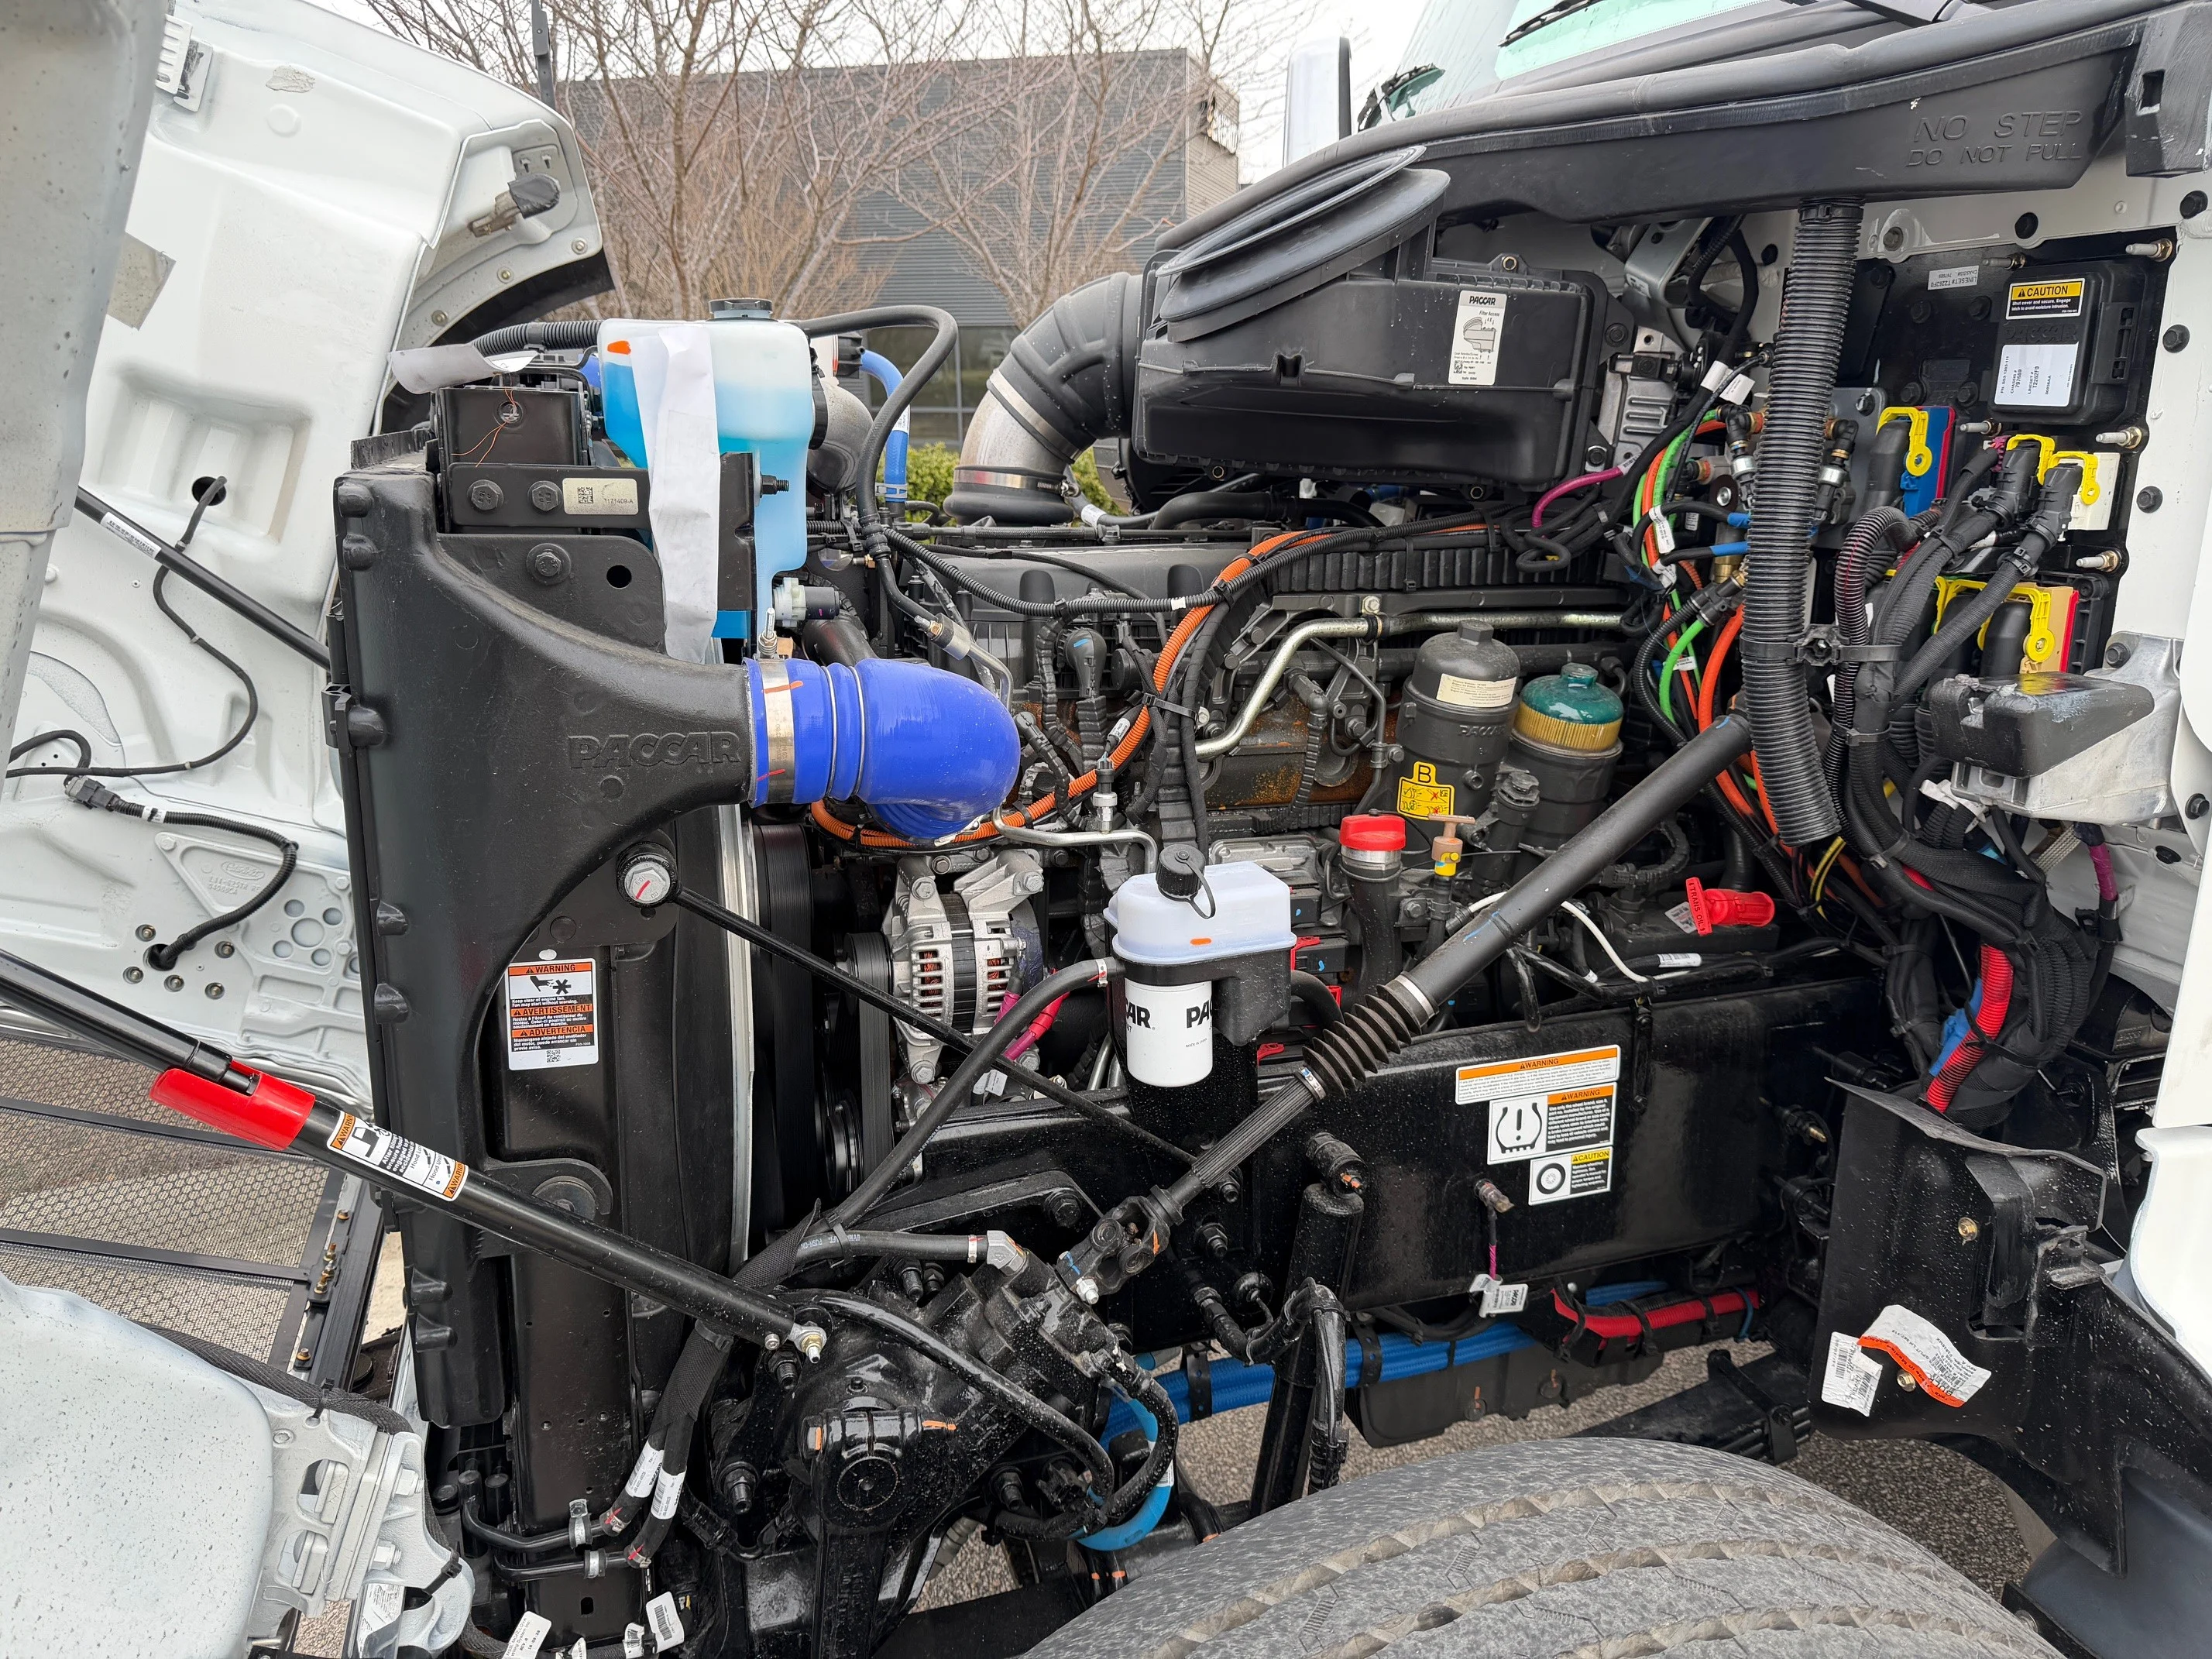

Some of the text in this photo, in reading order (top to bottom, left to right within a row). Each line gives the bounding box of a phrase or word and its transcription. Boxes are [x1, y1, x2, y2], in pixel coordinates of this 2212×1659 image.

[1914, 110, 2083, 143] NO STEP
[1906, 143, 2082, 167] DO NOT PULL
[2027, 286, 2069, 297] CAUTION
[1469, 296, 1496, 305] PACCAR
[568, 731, 741, 769] PACCAR
[1418, 764, 1431, 783] B
[1689, 887, 1701, 912] TRANS
[535, 964, 575, 973] WARNING
[523, 1005, 591, 1015] AVERTISSEMENT
[1126, 998, 1151, 1029] AR
[529, 1025, 586, 1036] ADVERTENCIA
[1525, 1058, 1559, 1070] WARNING
[1567, 1089, 1600, 1100] WARNING
[386, 1149, 397, 1170] ensure
[393, 1150, 406, 1172] engaged
[410, 1154, 421, 1170] Hood
[1578, 1151, 1609, 1161] CAUTION
[429, 1166, 438, 1181] Hood
